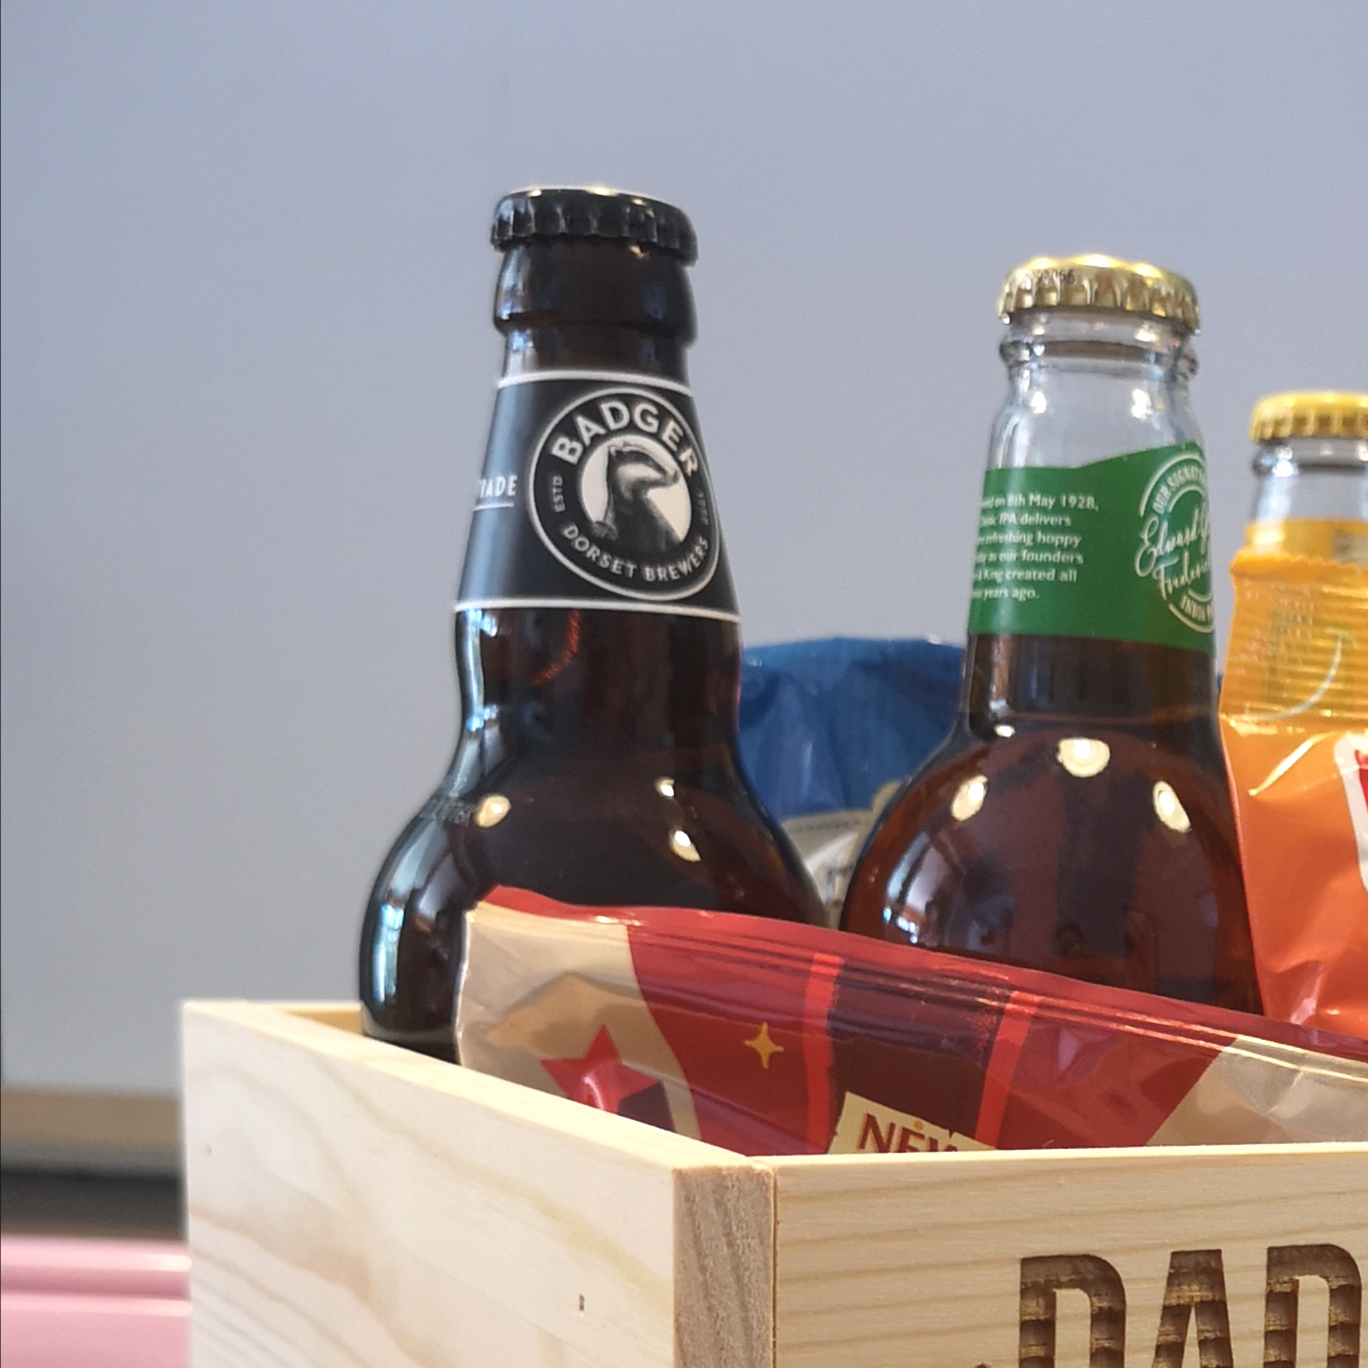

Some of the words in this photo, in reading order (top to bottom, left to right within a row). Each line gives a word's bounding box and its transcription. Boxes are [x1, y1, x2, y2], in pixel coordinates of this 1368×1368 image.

[551, 400, 698, 477] BADGER
[1028, 492, 1056, 510] May
[1020, 512, 1072, 527] delivers
[1036, 530, 1081, 549] hoppy
[563, 524, 638, 580] DORSET
[643, 536, 709, 583] BREWERS
[1020, 549, 1084, 565] founders
[1005, 567, 1056, 581] created
[1059, 569, 1078, 583] all
